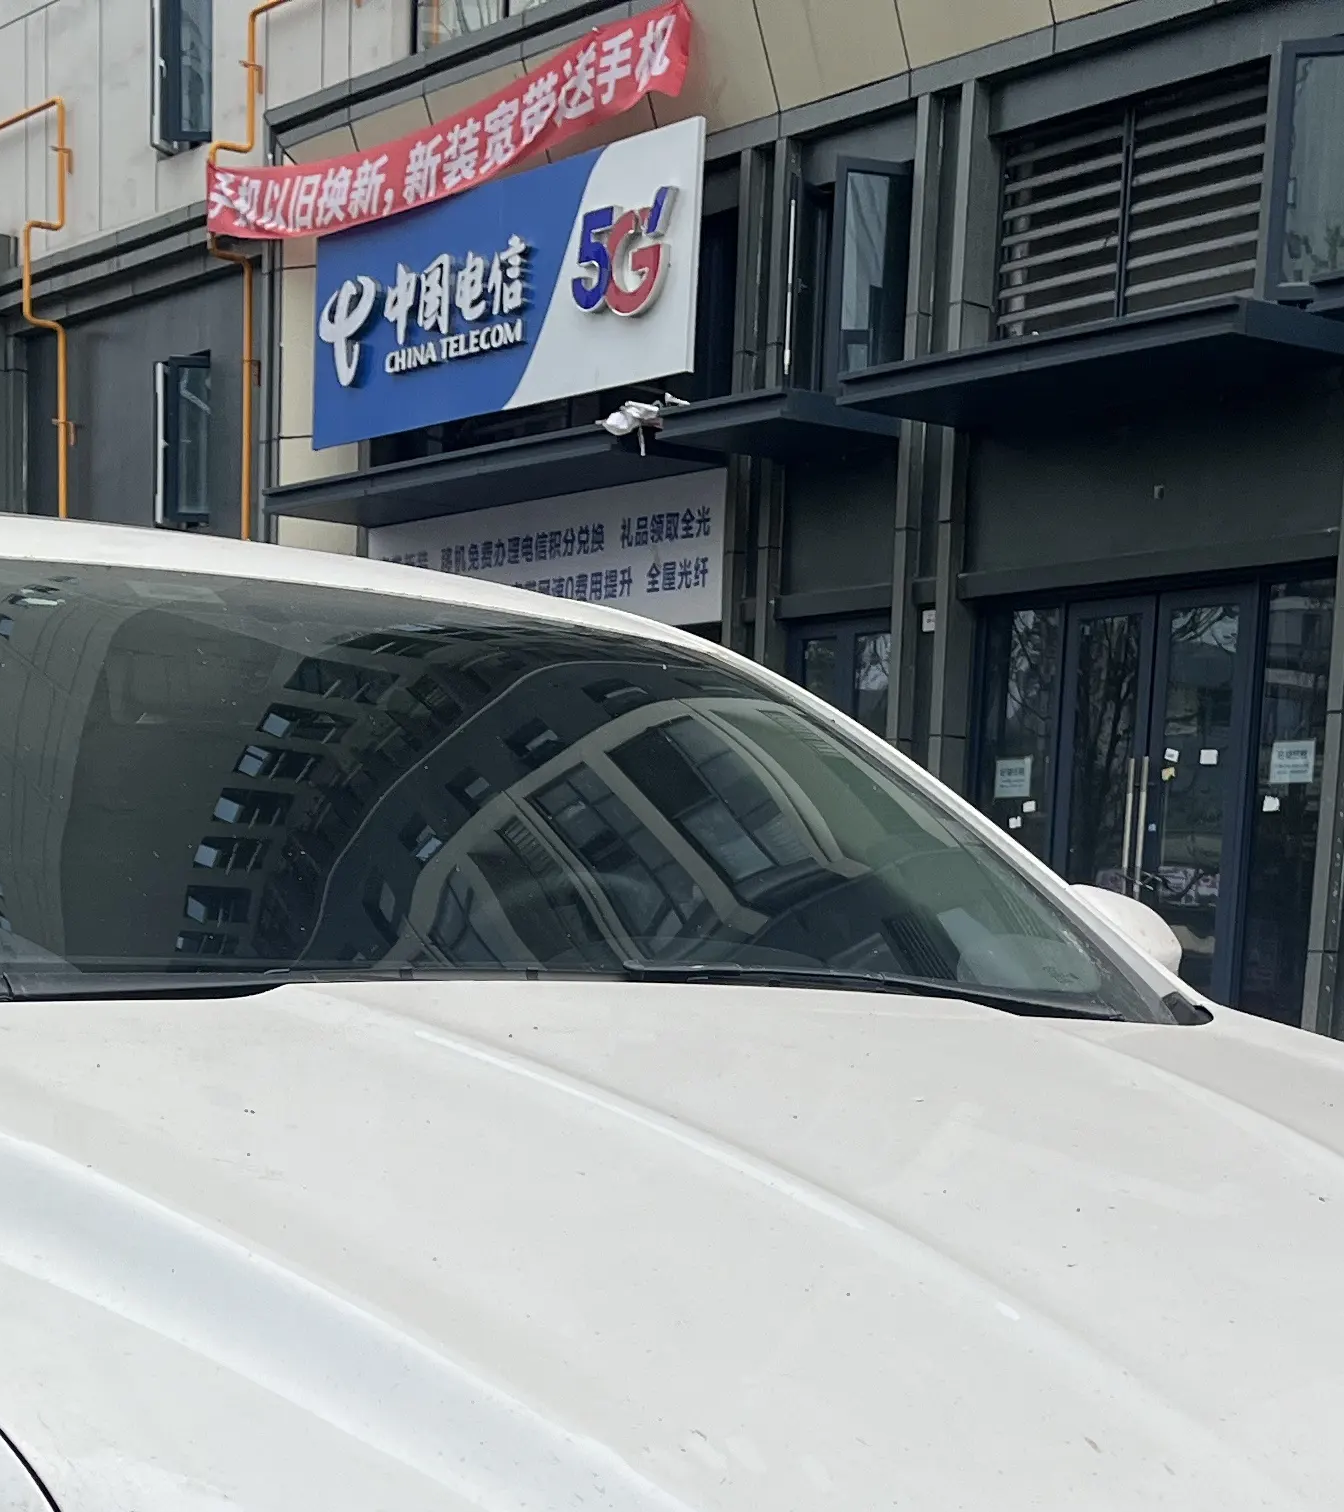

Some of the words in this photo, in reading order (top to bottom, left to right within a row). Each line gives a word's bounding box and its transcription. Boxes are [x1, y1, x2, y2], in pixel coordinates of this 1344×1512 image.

[571, 188, 672, 316] 5G
[384, 234, 526, 345] 中国电信
[385, 341, 437, 373] CHINA
[440, 318, 523, 361] TELECOM
[620, 505, 711, 549] 礼品领取全光
[646, 556, 708, 593] 全屋光纤
